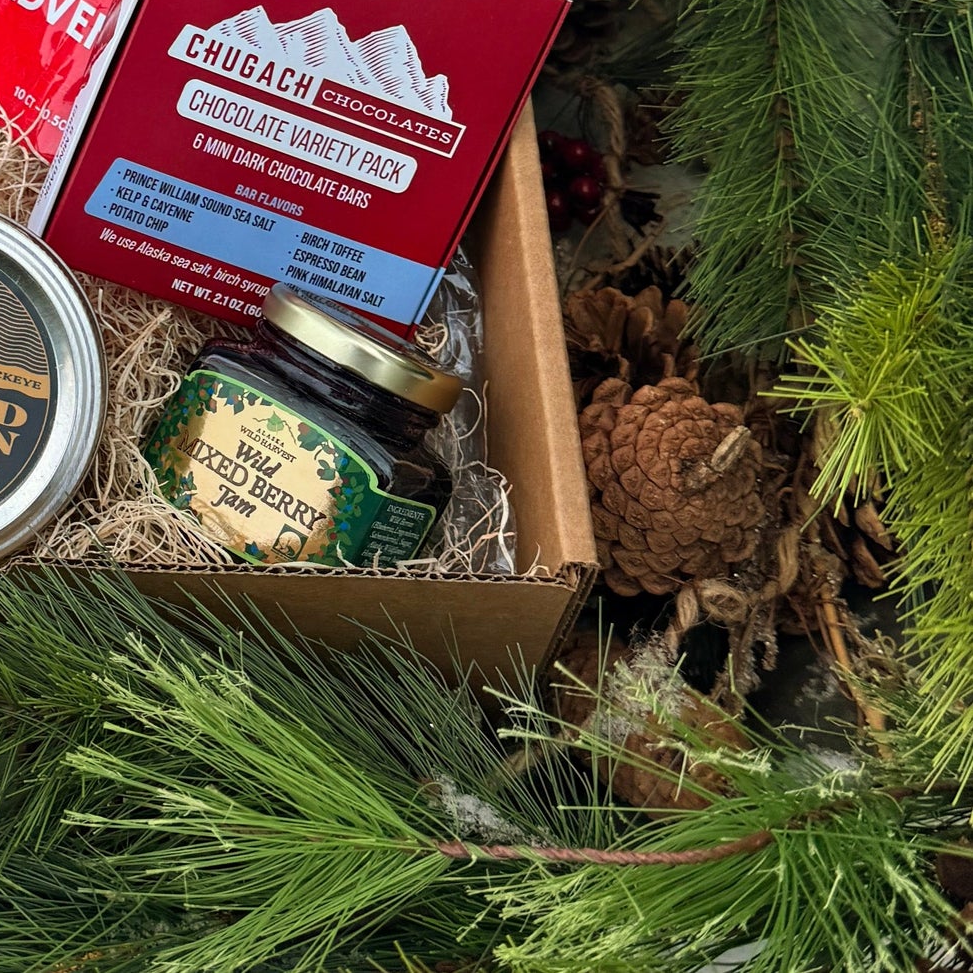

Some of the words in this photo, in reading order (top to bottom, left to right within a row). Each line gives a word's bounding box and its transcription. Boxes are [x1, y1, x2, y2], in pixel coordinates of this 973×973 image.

[185, 33, 314, 100] CHUGACH
[188, 88, 290, 144] CHOCOLATE
[289, 124, 361, 168] VARIETY
[359, 150, 407, 185] PACK
[321, 89, 453, 145] CHOCOLATES
[192, 132, 203, 150] 6
[203, 137, 233, 161] MINI
[232, 146, 268, 173] DARK
[267, 156, 340, 198] CHOCOLATE
[339, 184, 372, 209] BARS
[108, 202, 145, 225] POTATO
[144, 216, 169, 233] CHIP
[115, 185, 142, 204] KELP
[141, 195, 149, 208] &
[149, 198, 195, 223] CAYENNE
[122, 168, 160, 191] PRINCE
[158, 180, 201, 206] WILLIAM
[200, 196, 234, 217] SOUND
[232, 207, 252, 224] SEA
[251, 214, 276, 232] SALT
[235, 184, 258, 201] BAR
[257, 192, 305, 217] FLAVORS
[99, 227, 117, 244] We
[116, 234, 137, 250] use
[135, 241, 172, 263] Alaska
[170, 254, 191, 269] sea
[191, 259, 211, 279] salt,
[212, 267, 240, 287] birch
[240, 279, 270, 298] syrup
[292, 248, 341, 274] ESPRESSO
[340, 264, 367, 283] BEAN
[300, 231, 330, 251] BIRCH
[330, 241, 365, 264] TOFFEE
[171, 278, 194, 294] NET
[193, 285, 213, 301] WT.
[212, 293, 229, 306] 2.1
[228, 297, 245, 312] OZ
[285, 264, 311, 282] PINK
[310, 272, 362, 301] HIMALAYAN
[360, 291, 385, 308] SALT
[239, 425, 263, 443] WILD
[259, 437, 297, 464] HARVEST
[255, 428, 285, 448] ALASKA
[234, 439, 283, 479] Wild
[176, 428, 249, 487] MIXED
[247, 474, 327, 532] BERRY
[210, 483, 258, 519] Jam
